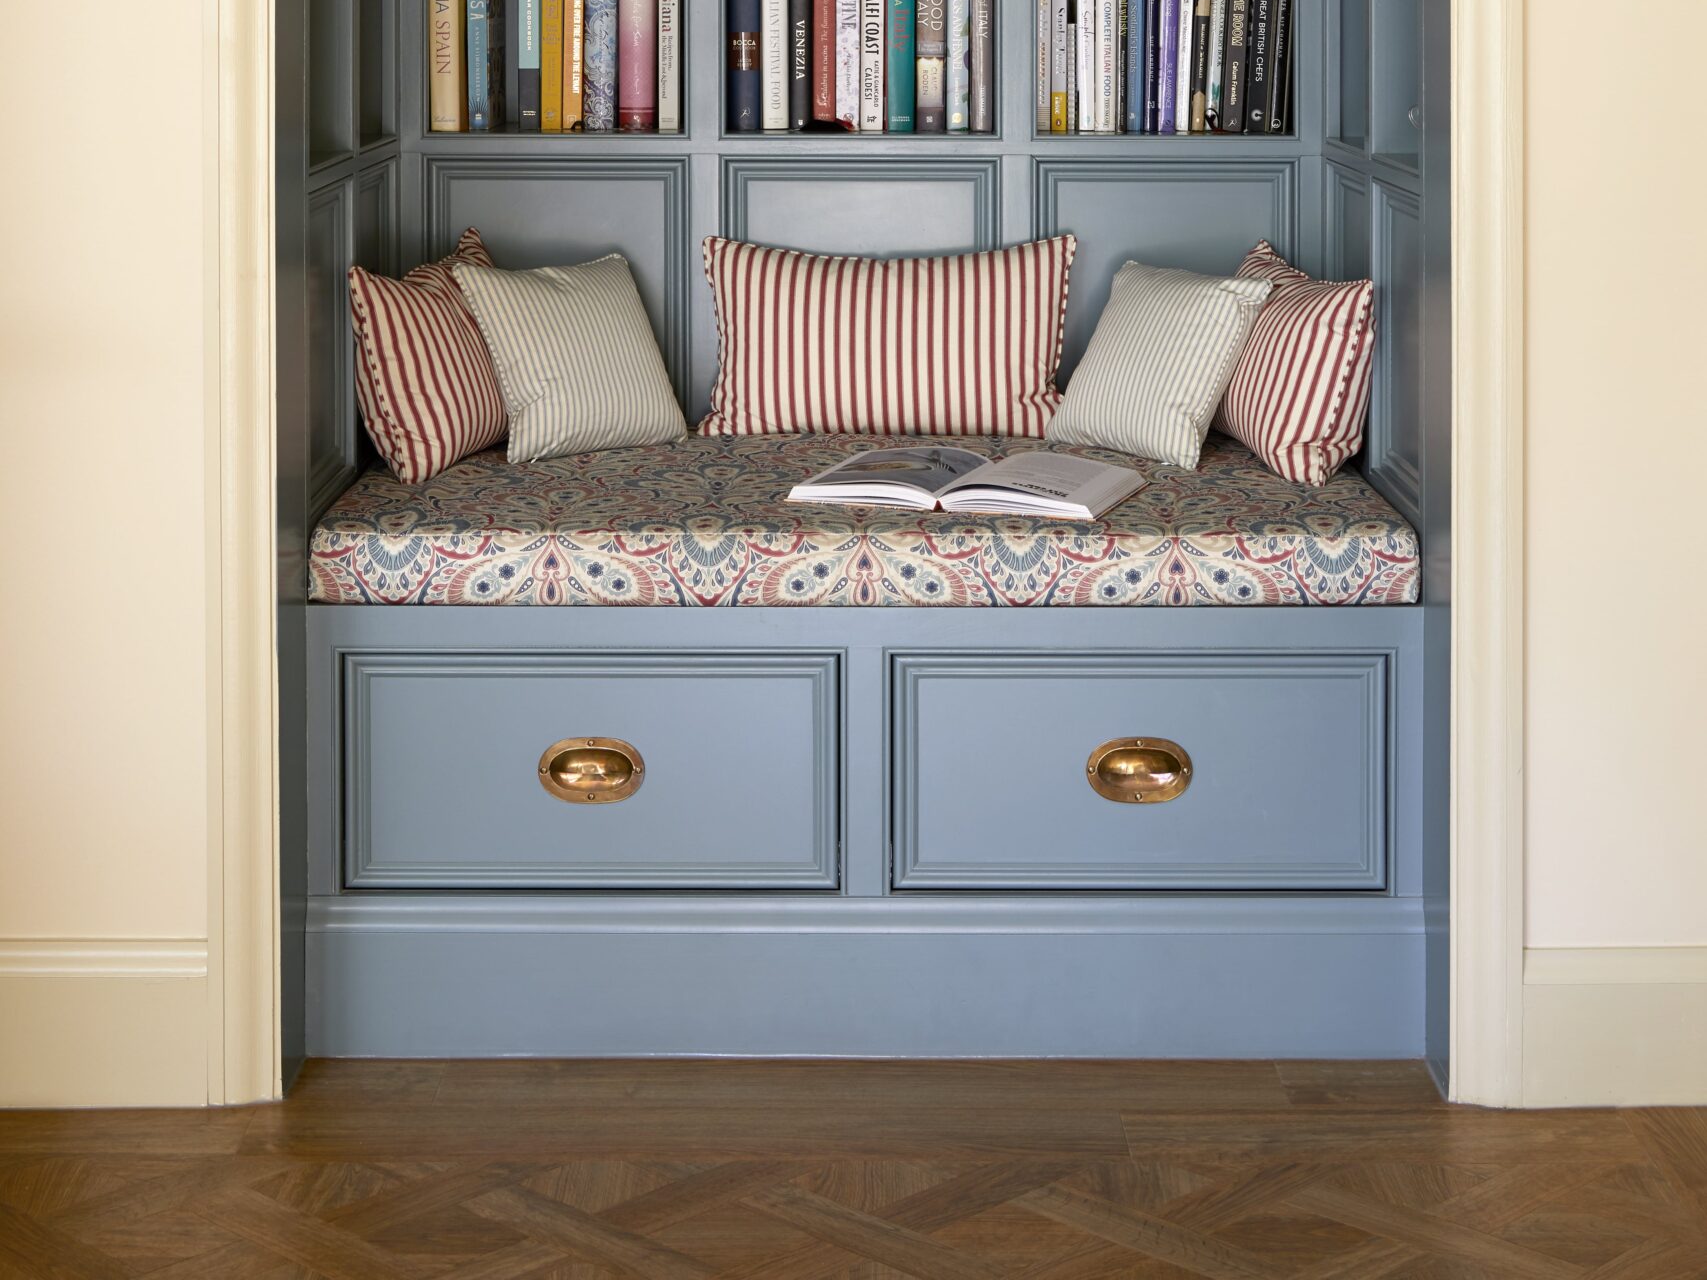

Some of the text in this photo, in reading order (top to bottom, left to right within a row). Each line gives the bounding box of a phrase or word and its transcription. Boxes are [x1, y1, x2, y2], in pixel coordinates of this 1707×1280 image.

[820, 30, 828, 41] The
[890, 9, 910, 51] Italy
[952, 16, 962, 36] AND
[978, 9, 988, 39] ITALY
[1119, 9, 1128, 36] whisky
[1130, 5, 1138, 43] Scotland's
[1232, 13, 1243, 46] ROOM
[1258, 22, 1266, 53] BRITISH
[436, 20, 450, 75] SPAIN
[770, 30, 780, 77] FESTIVAL
[796, 20, 806, 80] VENEZIA
[866, 23, 880, 55] COAST
[1053, 7, 1066, 75] Stanley Tucci
[1104, 1, 1112, 96] COMPLETE ITALIAN FOOD
[572, 61, 580, 72] THE
[952, 38, 962, 73] FENNEL
[1130, 45, 1138, 73] Islands
[1256, 56, 1264, 81] CHEFS
[572, 73, 580, 94] LEVANT
[770, 81, 780, 110] FOOD
[1230, 80, 1238, 105] Franklin
